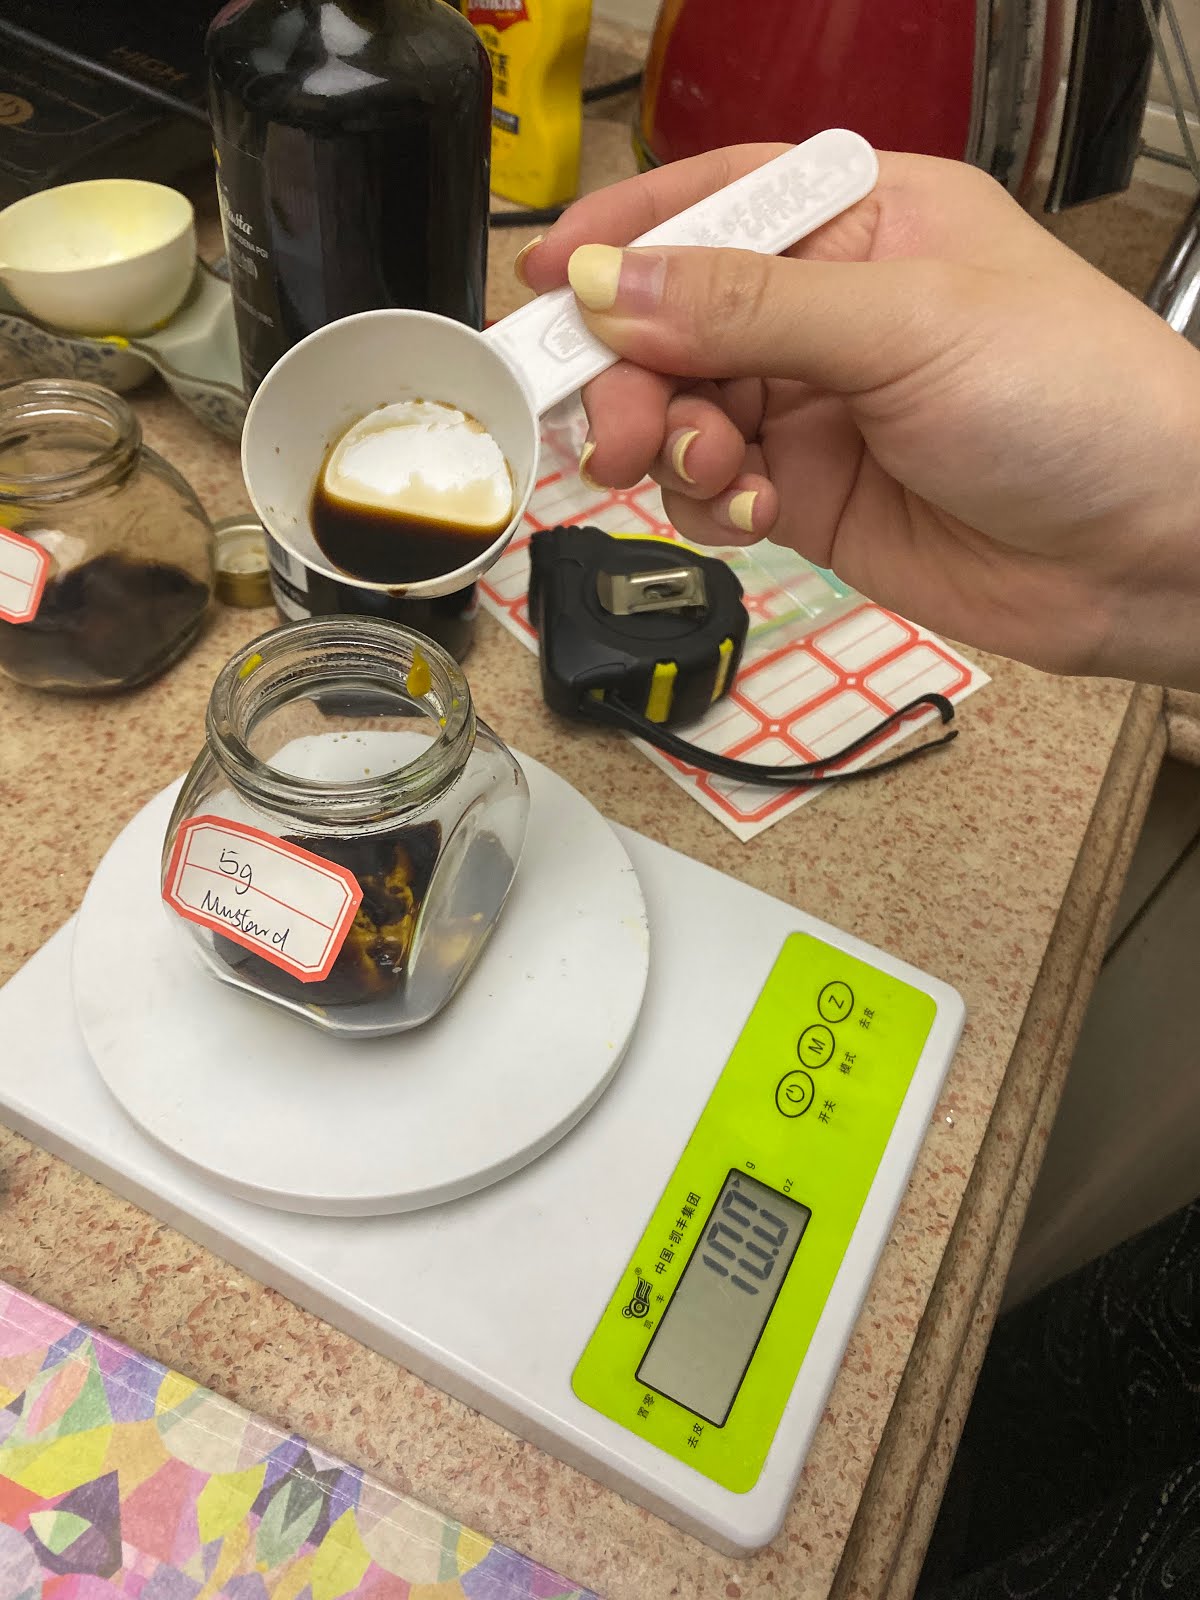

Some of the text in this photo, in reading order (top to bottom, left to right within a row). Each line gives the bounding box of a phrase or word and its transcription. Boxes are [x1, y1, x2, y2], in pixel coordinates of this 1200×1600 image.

[200, 889, 290, 952] Mustard
[828, 994, 845, 1009] Z
[858, 1007, 875, 1029] 去皮
[807, 1037, 826, 1055] M
[839, 1051, 857, 1075] 模式
[818, 1099, 837, 1124] 开关
[782, 1178, 794, 1193] oz
[702, 1189, 789, 1296] 10.0
[687, 1422, 704, 1449] 去皮
